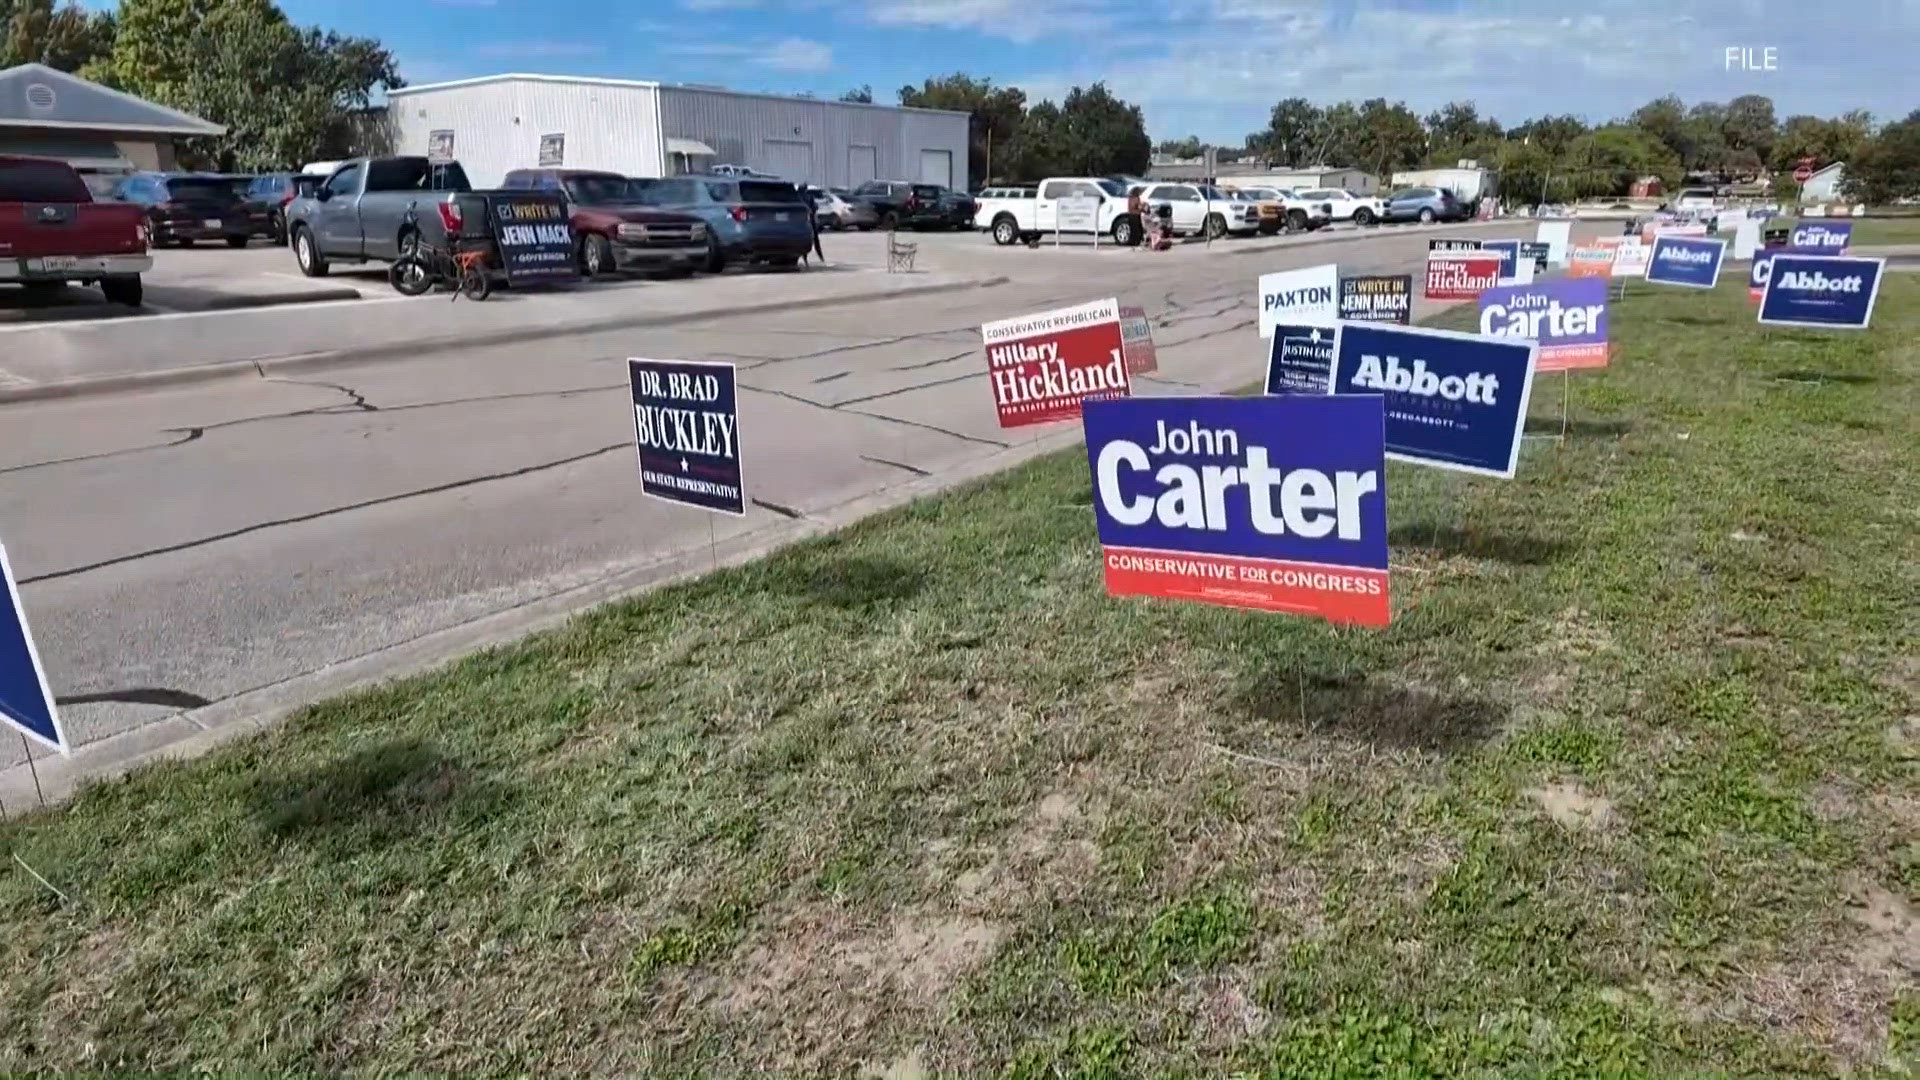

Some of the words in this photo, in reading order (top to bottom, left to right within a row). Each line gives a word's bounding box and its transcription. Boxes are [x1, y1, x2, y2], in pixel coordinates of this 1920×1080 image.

[512, 203, 547, 218] WRITE
[501, 225, 537, 245] JENN
[537, 224, 571, 243] MACK
[1794, 230, 1849, 246] Carter
[1658, 246, 1712, 264] Abbott
[1430, 261, 1467, 273] Hillary
[1358, 280, 1391, 294] WRITE
[1393, 280, 1404, 292] IN
[1427, 271, 1497, 290] Hickland
[1777, 271, 1862, 293] Abbott
[1265, 285, 1331, 312] PAXTON
[1342, 295, 1371, 311] JENN
[1373, 293, 1408, 310] MACK
[1507, 293, 1548, 309] John
[986, 319, 1052, 339] CONSERVATIVE
[1054, 308, 1112, 328] REPUBLICAN
[1351, 312, 1396, 320] GOVERNOR
[1480, 300, 1604, 338] Carter
[991, 341, 1058, 368] Hillary
[1284, 345, 1314, 358] JUSTIN
[1314, 347, 1334, 359] EAR
[640, 371, 667, 398] DR.
[668, 373, 719, 401] BRAD
[993, 348, 1127, 405] Hickland
[1351, 354, 1499, 406] Abbott
[1020, 401, 1046, 413] STATE
[635, 404, 735, 458] BUCKLEY
[1149, 420, 1238, 455] John
[656, 472, 676, 488] STATE
[676, 477, 739, 499] REPRESENTATIVE
[1098, 439, 1377, 541] Carter
[1108, 554, 1235, 580] CONSERVATIVE
[1240, 566, 1268, 583] FOR
[1273, 568, 1380, 595] CONGRESS
